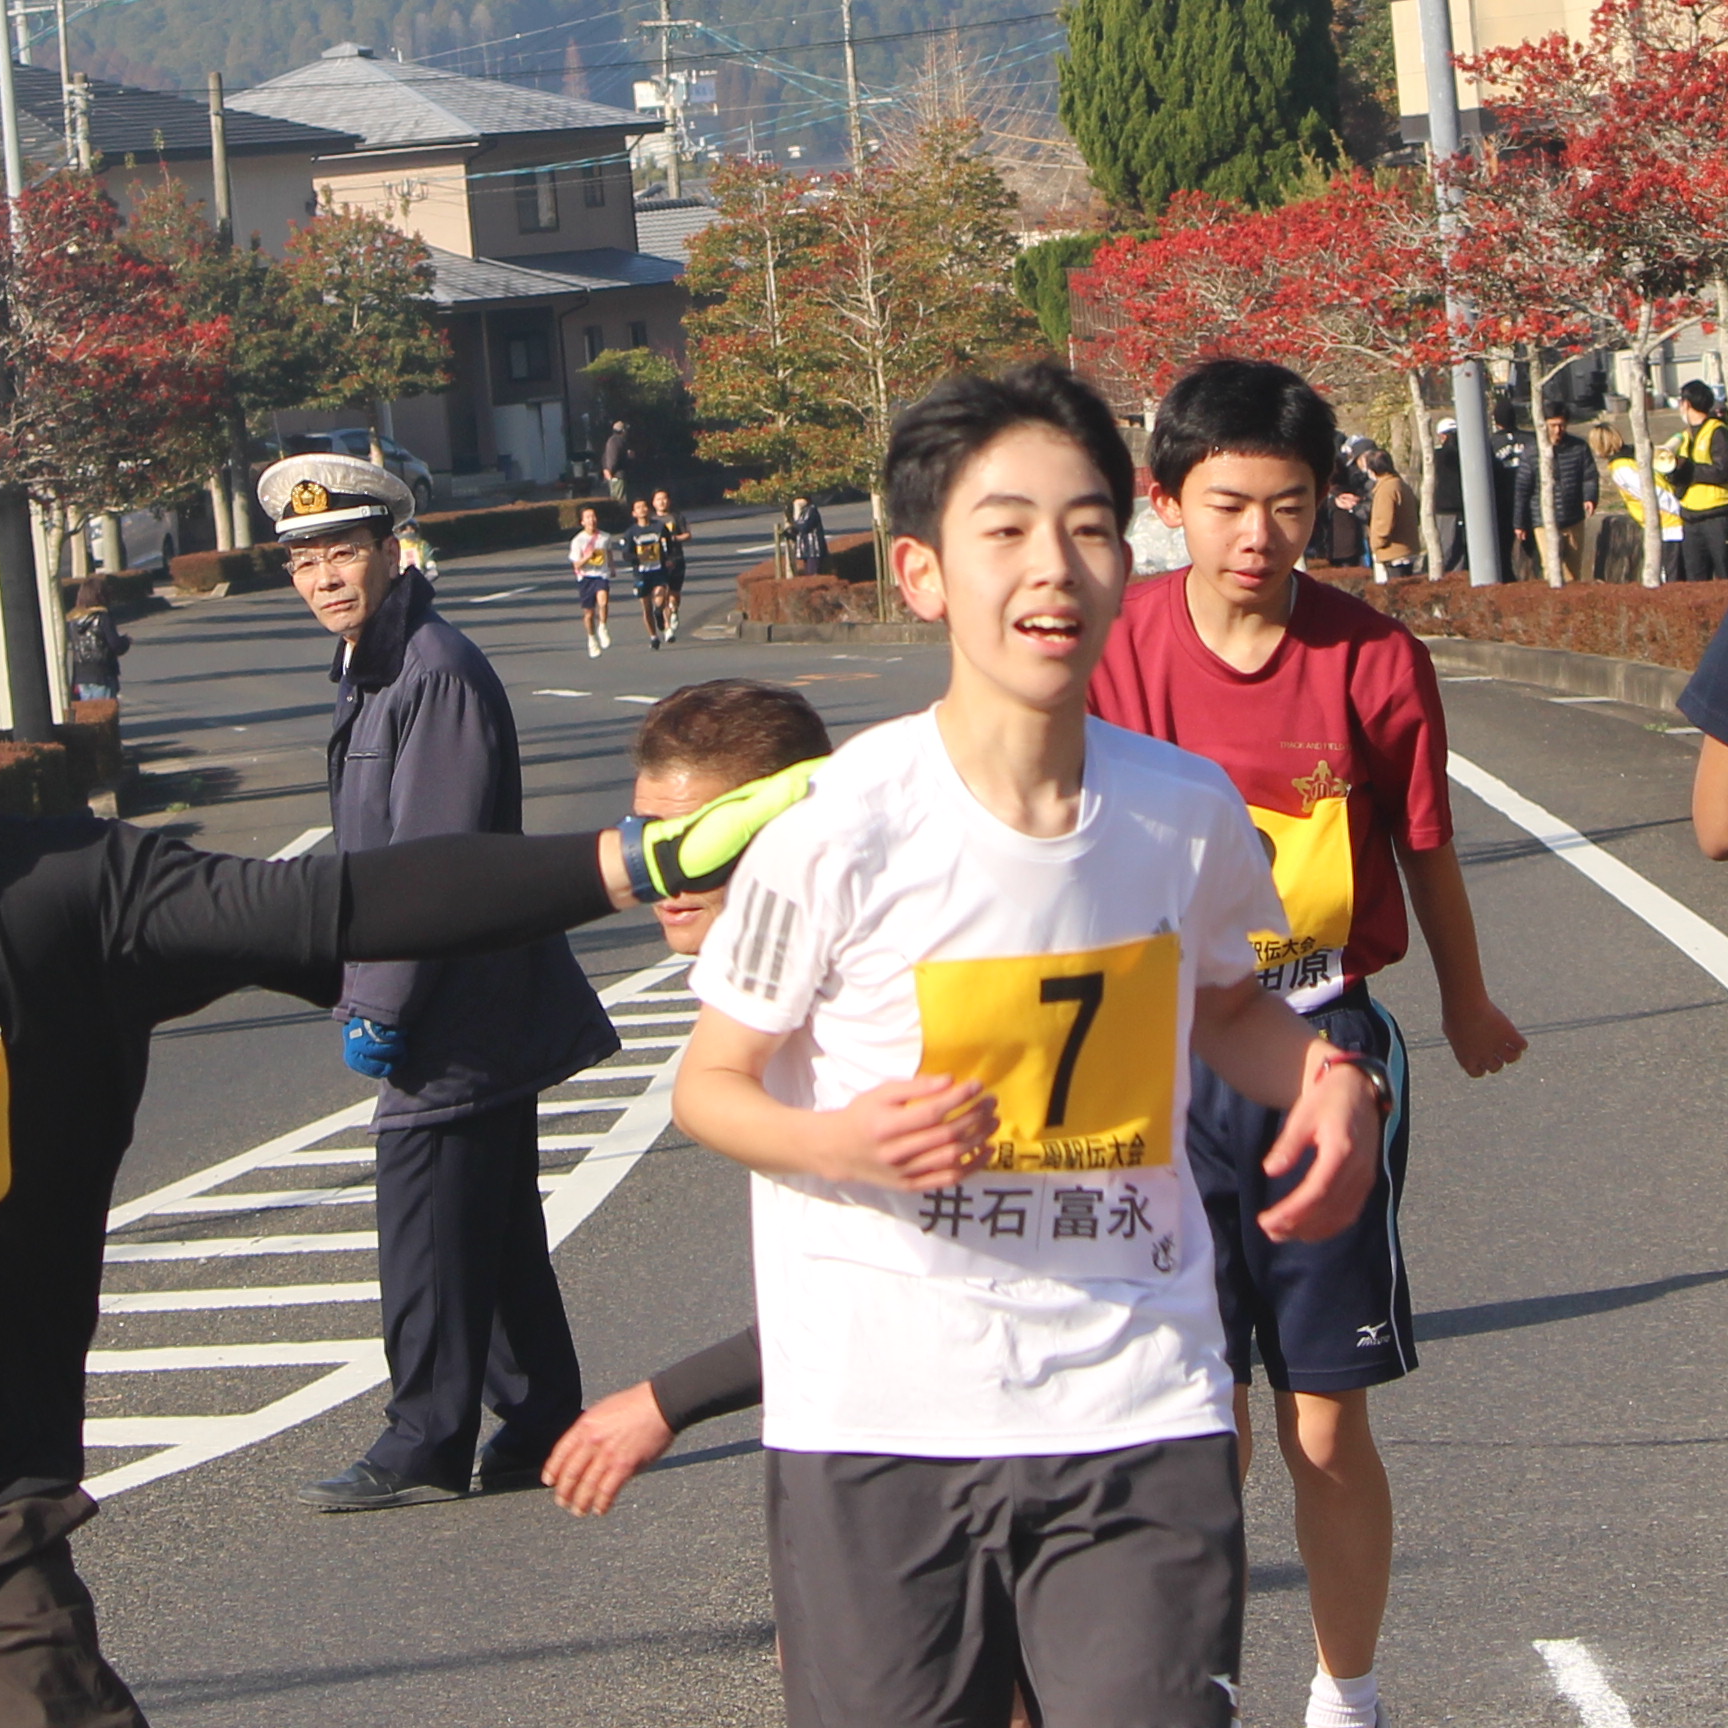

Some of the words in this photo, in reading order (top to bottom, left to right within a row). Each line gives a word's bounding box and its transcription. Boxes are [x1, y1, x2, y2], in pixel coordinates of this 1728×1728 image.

[1039, 970, 1105, 1128] 7
[918, 1183, 1033, 1240] 井石
[1053, 1183, 1154, 1240] 富永
